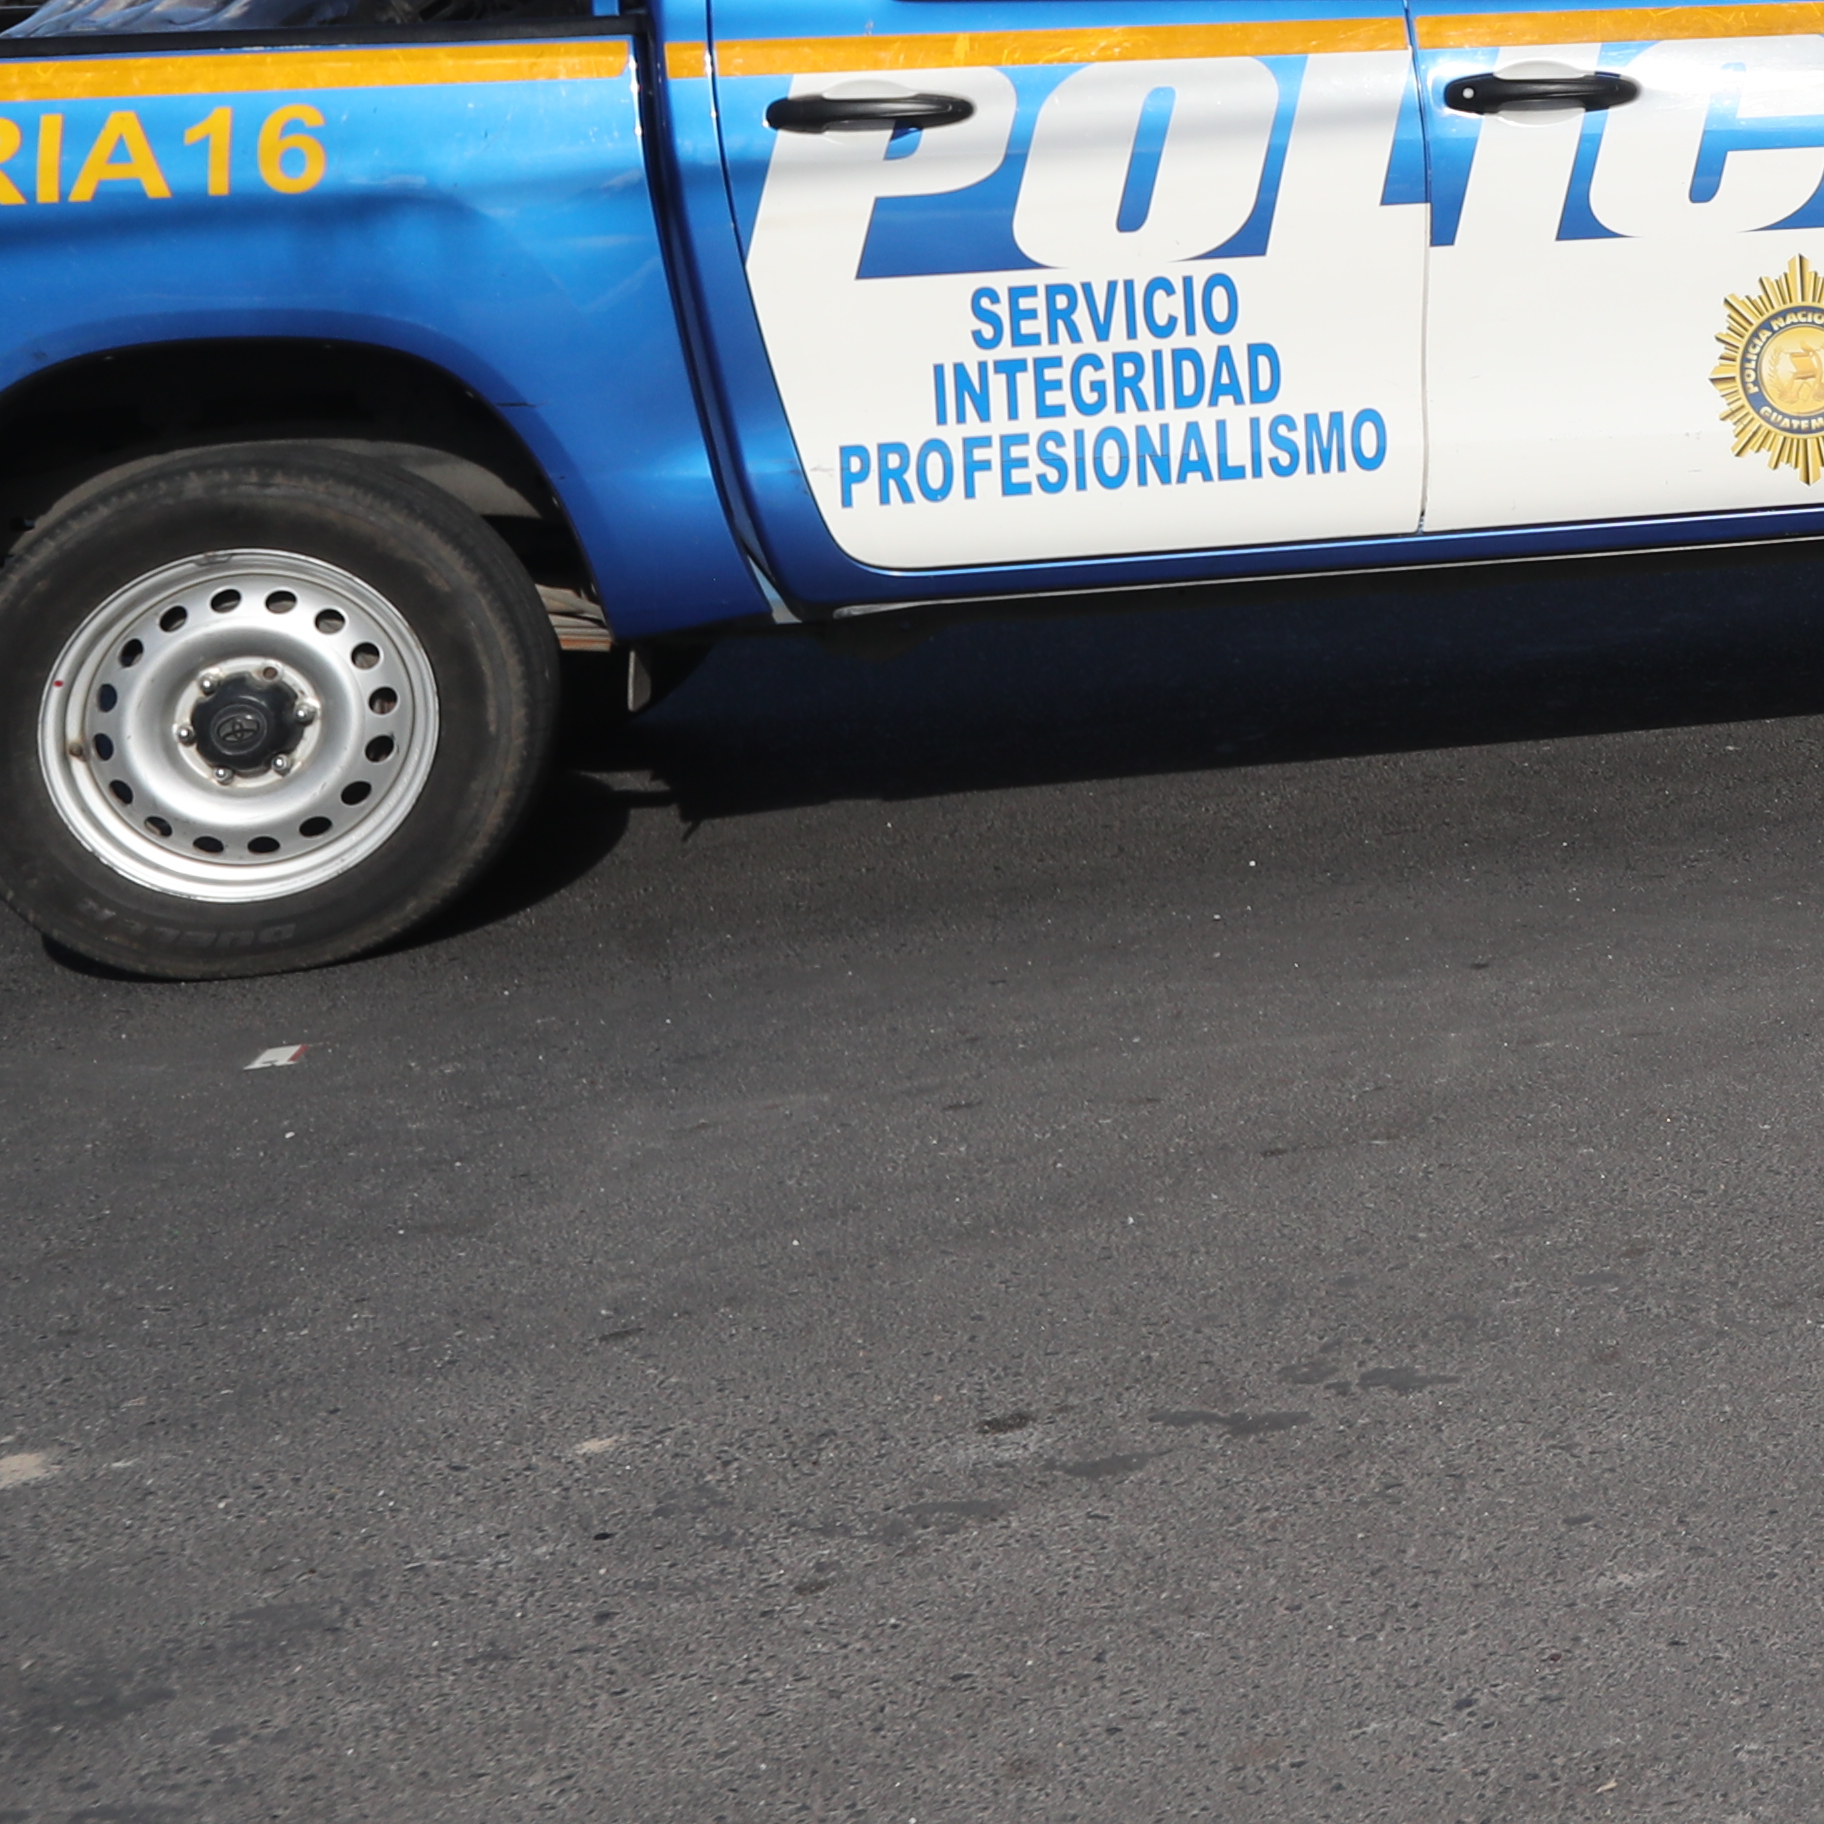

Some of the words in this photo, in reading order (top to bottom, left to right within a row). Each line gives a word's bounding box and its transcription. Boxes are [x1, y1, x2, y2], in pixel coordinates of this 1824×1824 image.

[970, 272, 1241, 351] SERVICIO
[932, 341, 1282, 427] INTEGRIDAD
[1743, 327, 1773, 395] POLICIA
[837, 407, 1388, 510] PROFESIONALISMO
